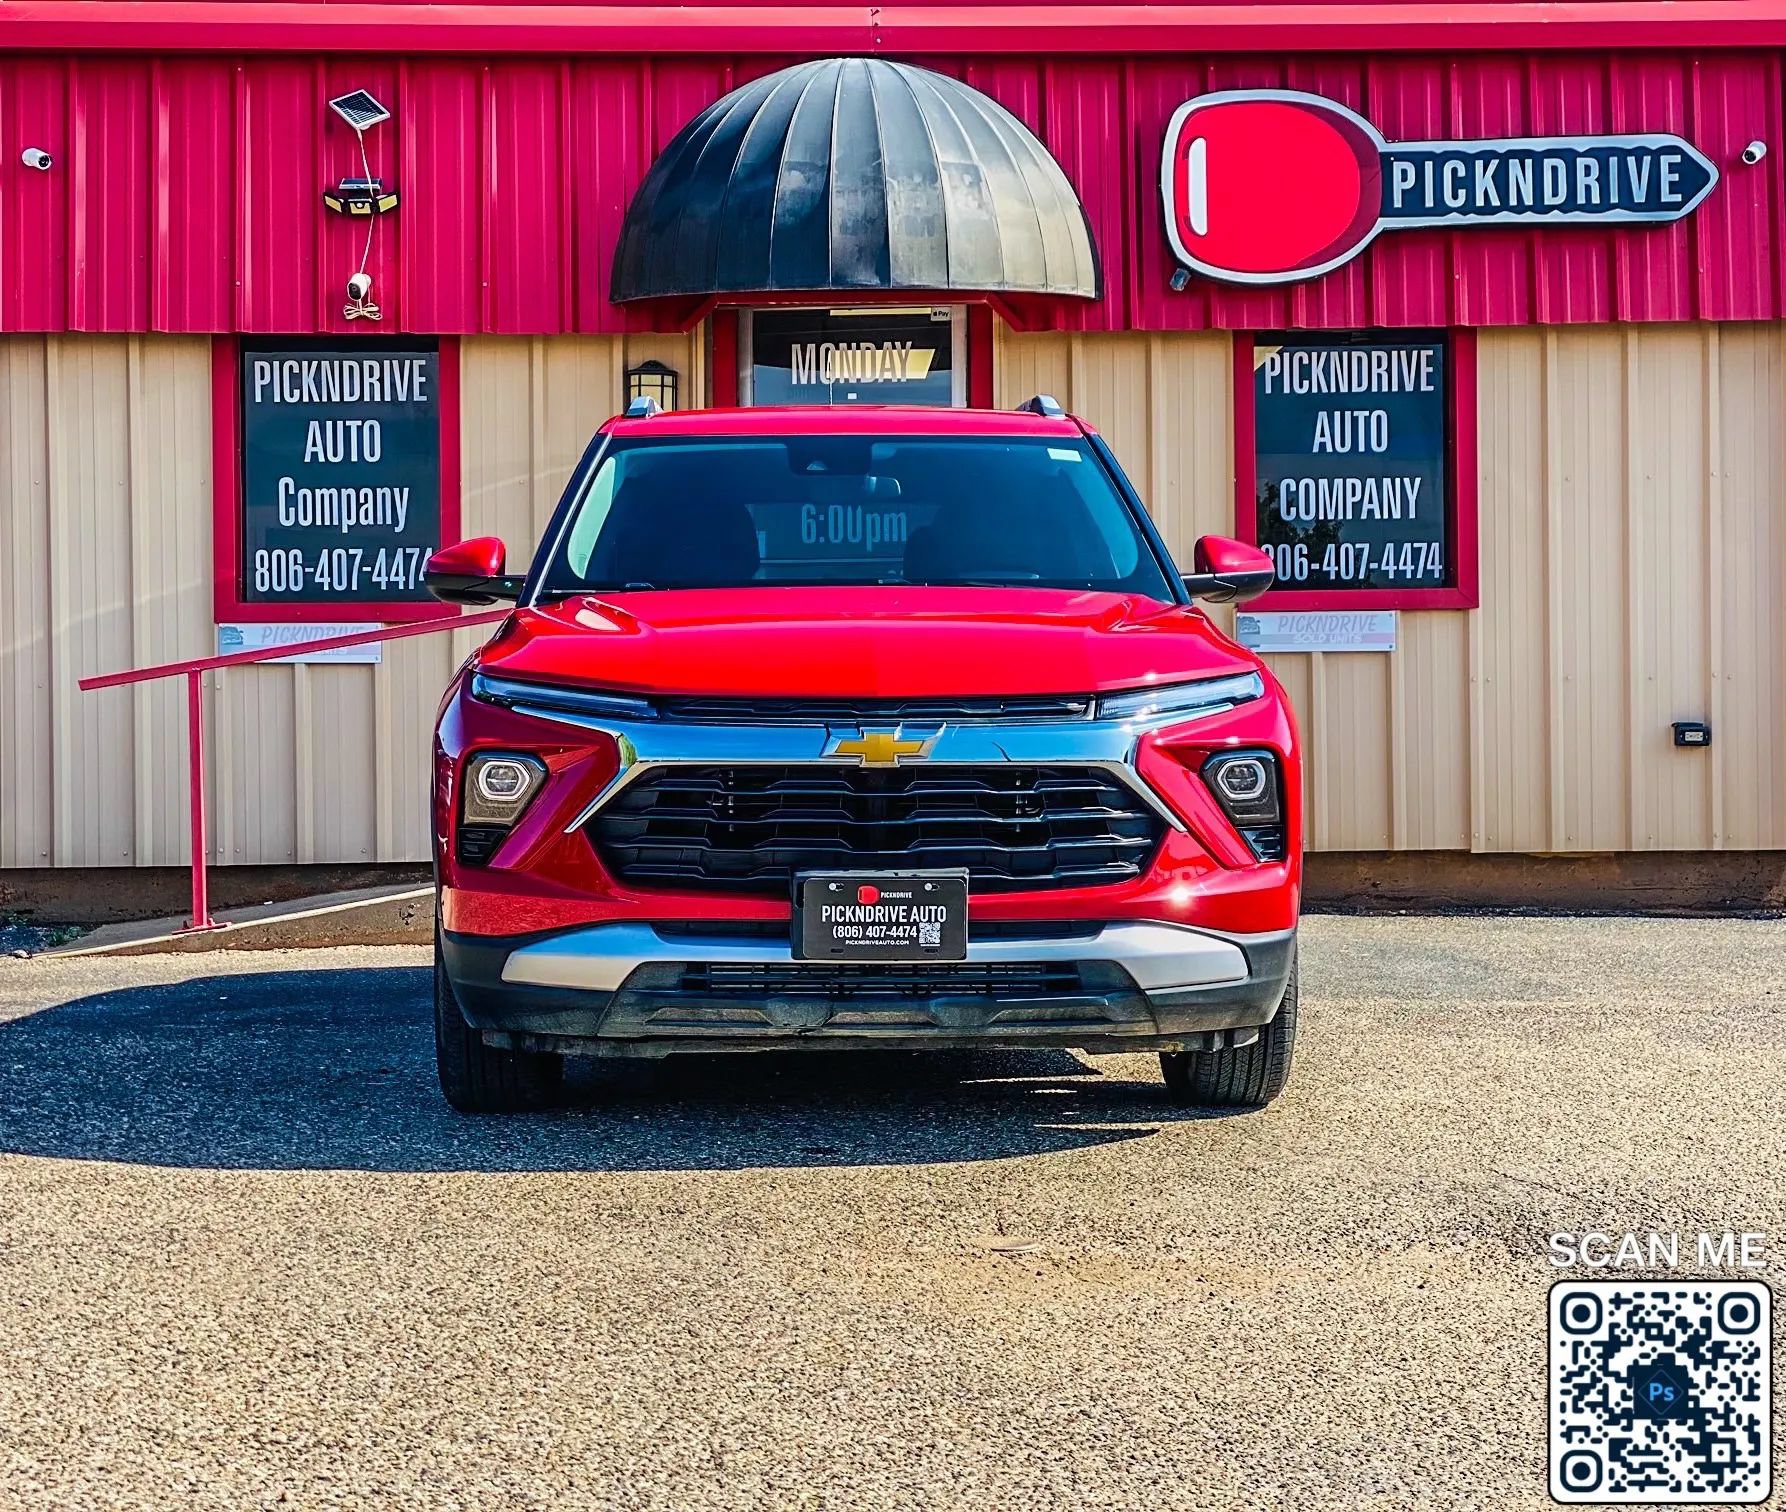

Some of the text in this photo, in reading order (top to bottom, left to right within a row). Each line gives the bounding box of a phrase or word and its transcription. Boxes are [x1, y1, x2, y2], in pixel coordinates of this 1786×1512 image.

[1393, 154, 1683, 208] PICKNDRIVE
[254, 360, 428, 403] PICKNDRIVE
[791, 341, 912, 385] MONDAY
[1265, 350, 1435, 394] PICKNDRIVE
[304, 419, 382, 463] AUTO
[1312, 409, 1389, 453] AUTO
[278, 476, 410, 533] Company
[1279, 477, 1422, 522] COMPANY
[1277, 615, 1378, 633] PICKNDRIVE
[821, 905, 947, 923] PICKNDRIVE AUTO
[880, 891, 913, 899] PICKNDRIVE
[832, 925, 918, 939] (806) 407-4474
